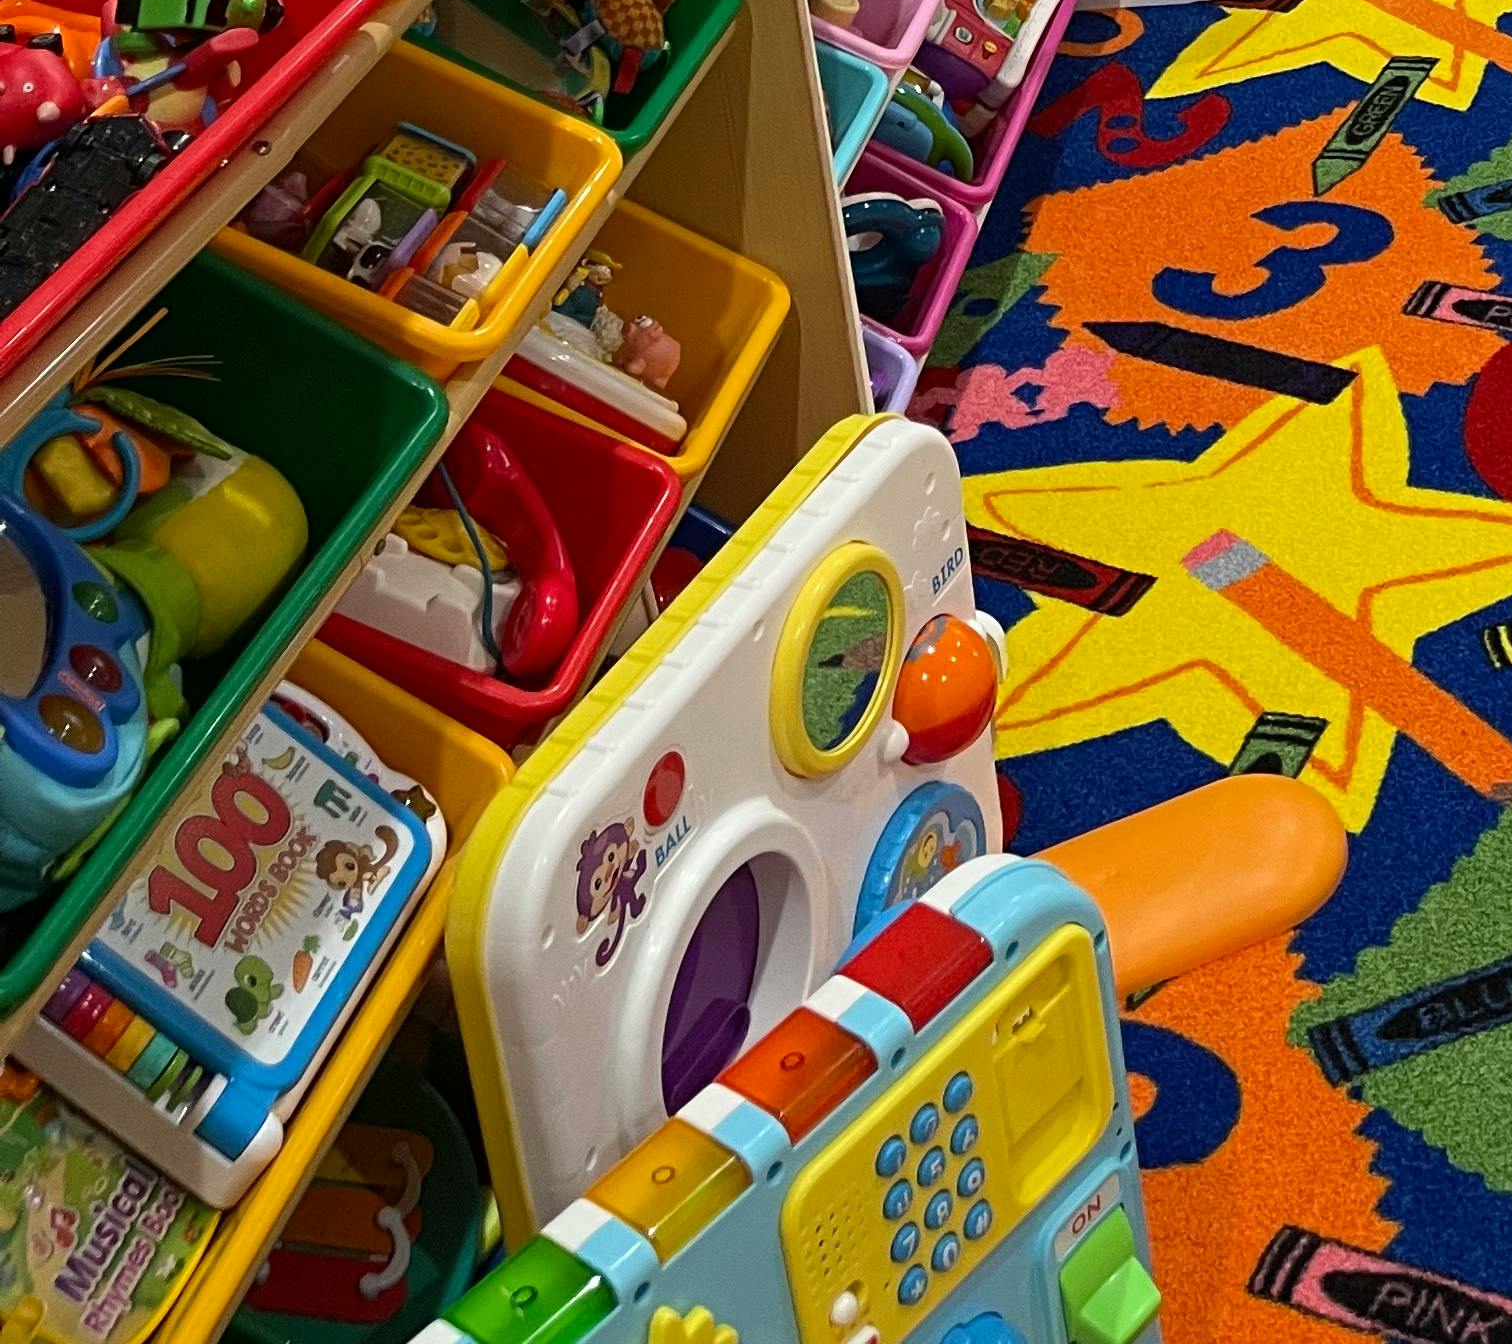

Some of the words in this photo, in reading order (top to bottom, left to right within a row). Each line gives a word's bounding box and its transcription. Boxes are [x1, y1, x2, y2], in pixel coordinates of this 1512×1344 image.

[1352, 84, 1404, 137] GREEN
[1152, 200, 1395, 320] 3
[931, 547, 963, 594] BIRD
[148, 769, 292, 949] 100
[655, 815, 691, 867] BALL
[225, 879, 278, 954] WORDS
[268, 825, 318, 884] BOOK
[55, 1159, 158, 1303] Musical
[902, 1231, 915, 1257] 7
[1072, 1195, 1102, 1234] ON
[83, 1238, 152, 1335] Rhymes
[141, 1184, 183, 1237] Boo
[1371, 1280, 1505, 1344] PINK
